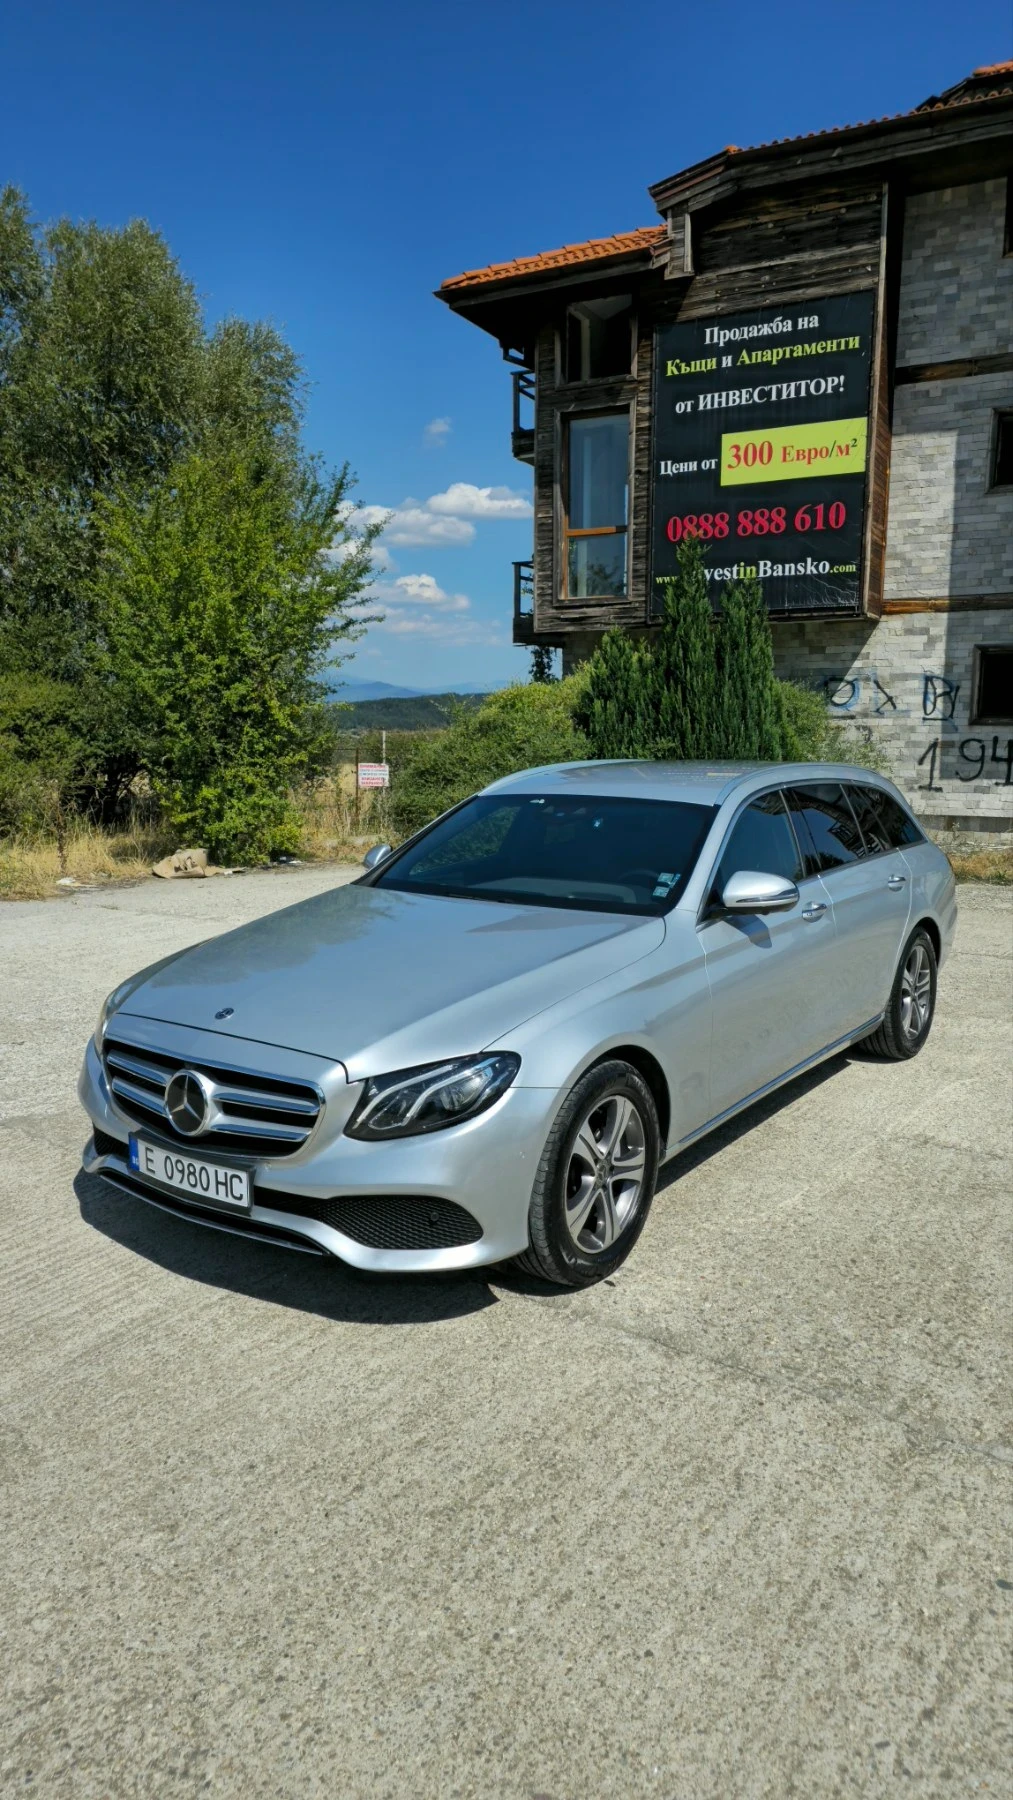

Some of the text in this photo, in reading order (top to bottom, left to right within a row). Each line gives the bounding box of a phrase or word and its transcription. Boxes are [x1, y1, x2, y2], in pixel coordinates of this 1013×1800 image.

[704, 314, 819, 346] Продажба на
[665, 335, 860, 377] Къщи и Апартаменти
[675, 375, 846, 414] от ИНВЕСТИТОР!
[659, 459, 698, 476] Цени
[701, 457, 718, 471] от
[727, 440, 773, 469] 300
[666, 501, 847, 542] 0888 888 610
[144, 1146, 156, 1174] E
[164, 1155, 210, 1192] 0980
